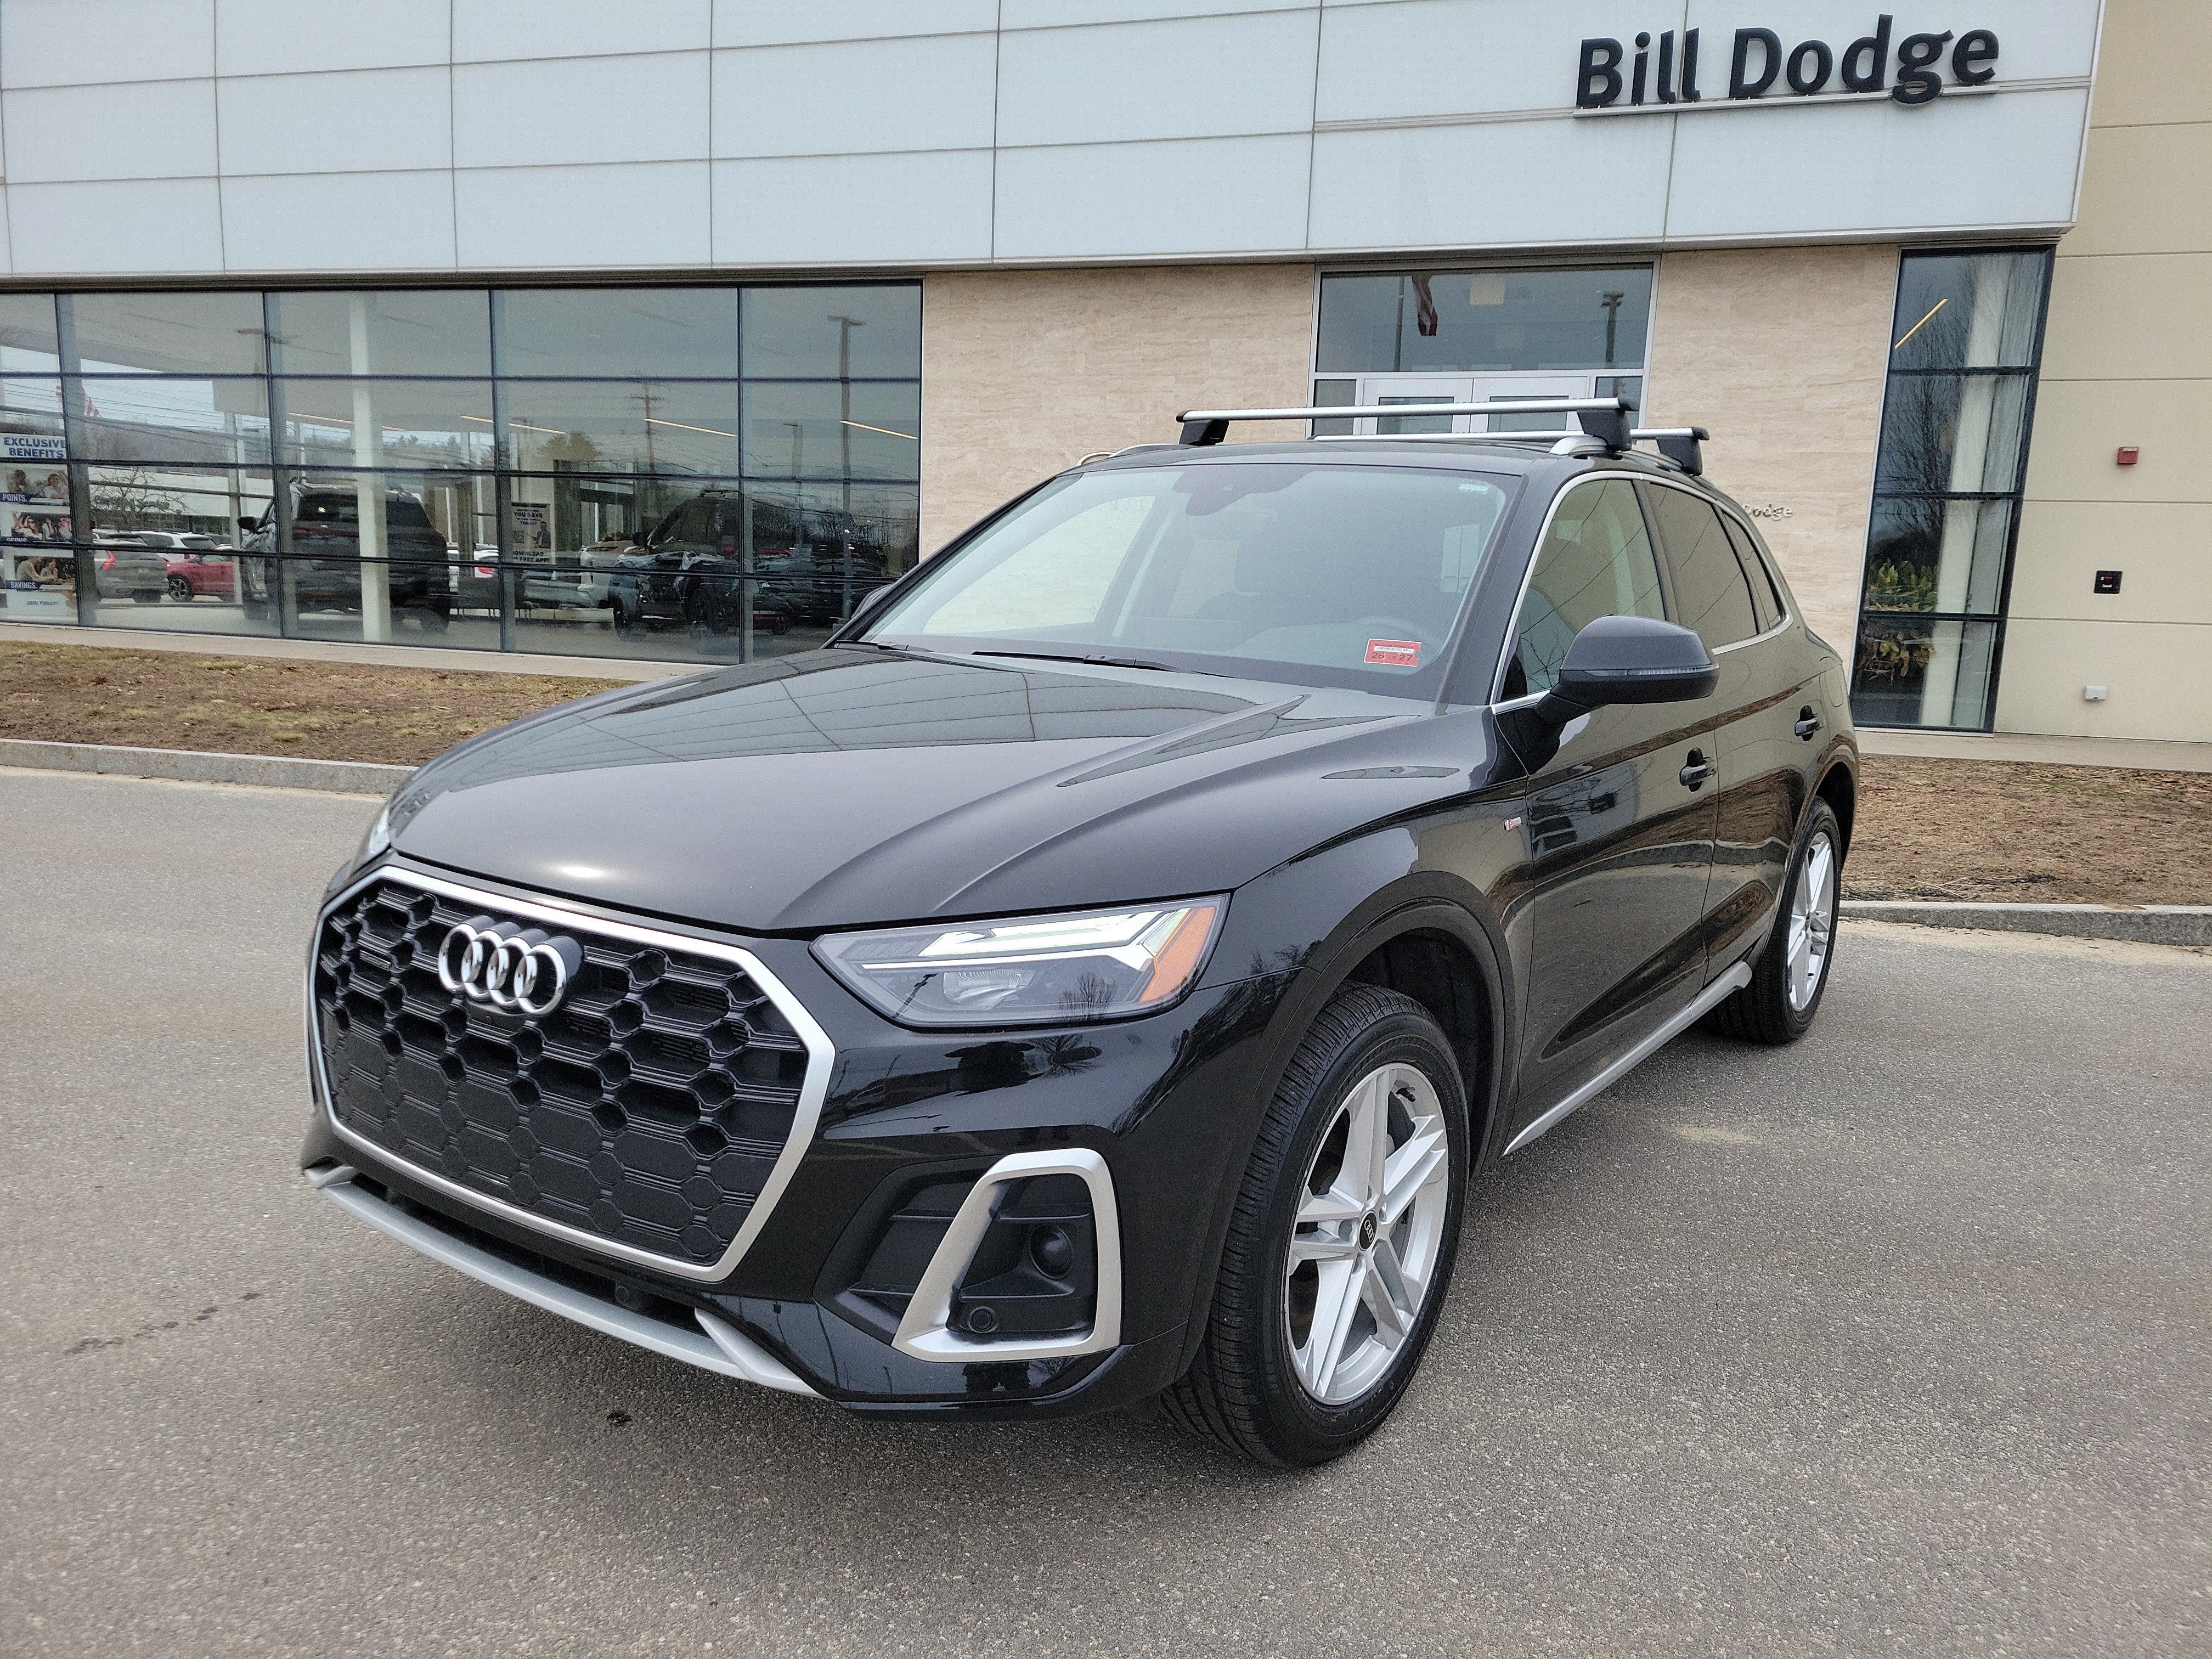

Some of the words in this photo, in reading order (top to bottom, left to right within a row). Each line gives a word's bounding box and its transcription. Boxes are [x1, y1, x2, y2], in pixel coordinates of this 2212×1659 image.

[1576, 27, 1700, 107] Bill
[1728, 14, 2000, 105] Dodge
[4, 437, 66, 448] EXCLUSIVE
[9, 447, 64, 459] BENEFITS
